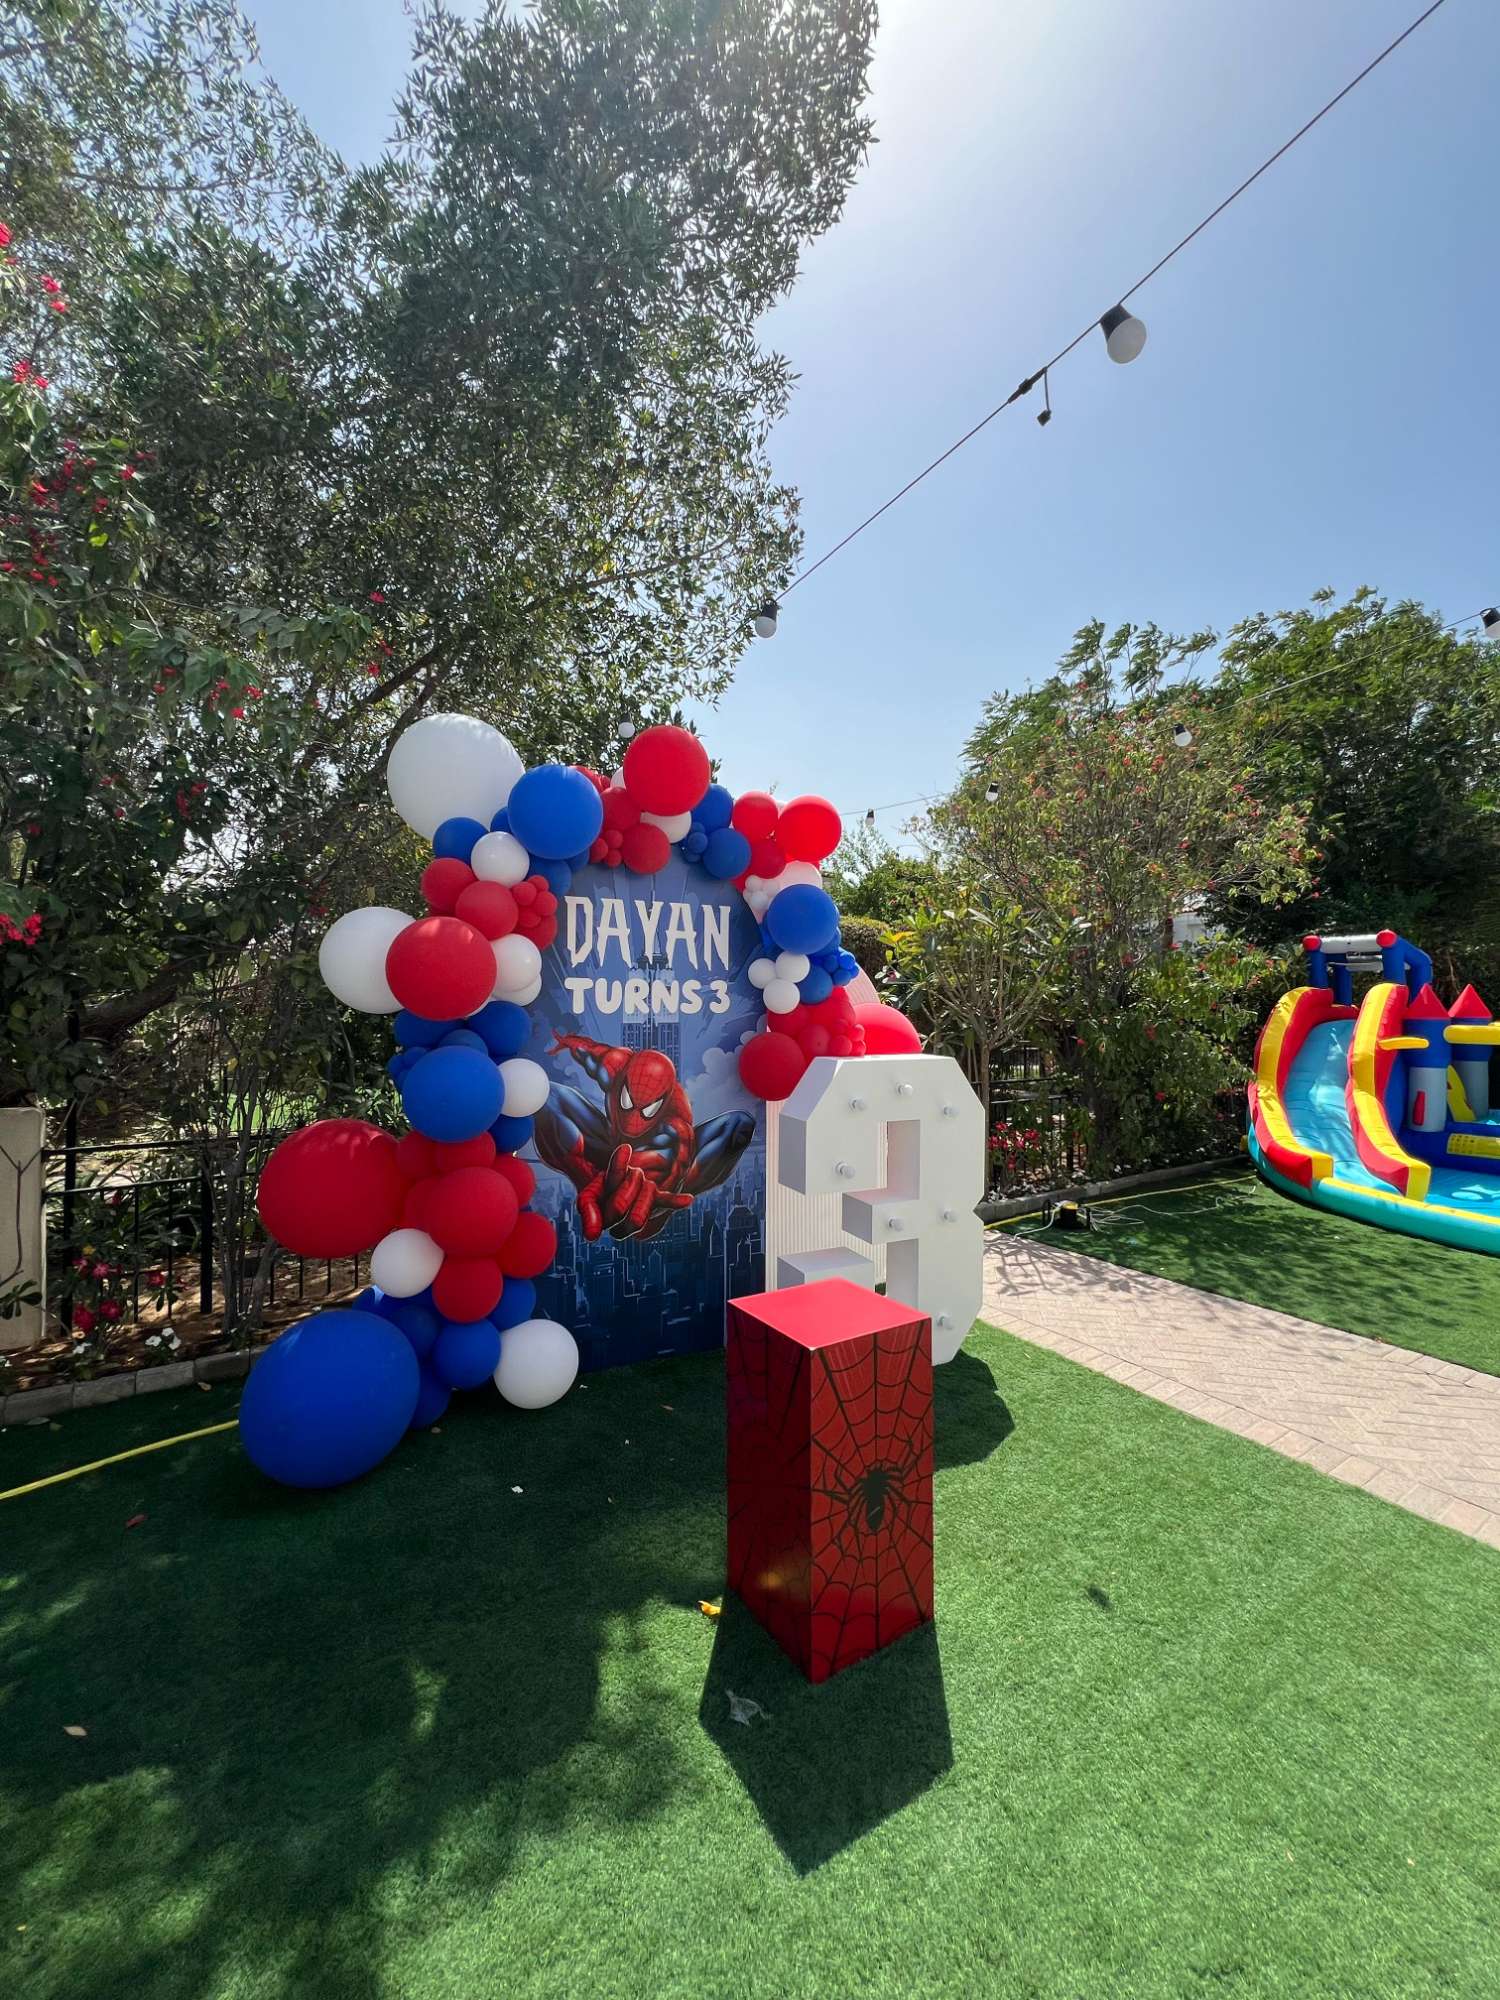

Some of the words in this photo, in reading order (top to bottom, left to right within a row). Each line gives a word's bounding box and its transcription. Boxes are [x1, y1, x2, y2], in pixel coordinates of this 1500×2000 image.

[564, 895, 731, 971] DAYAN
[564, 977, 702, 1015] TURNS
[709, 979, 731, 1014] 3
